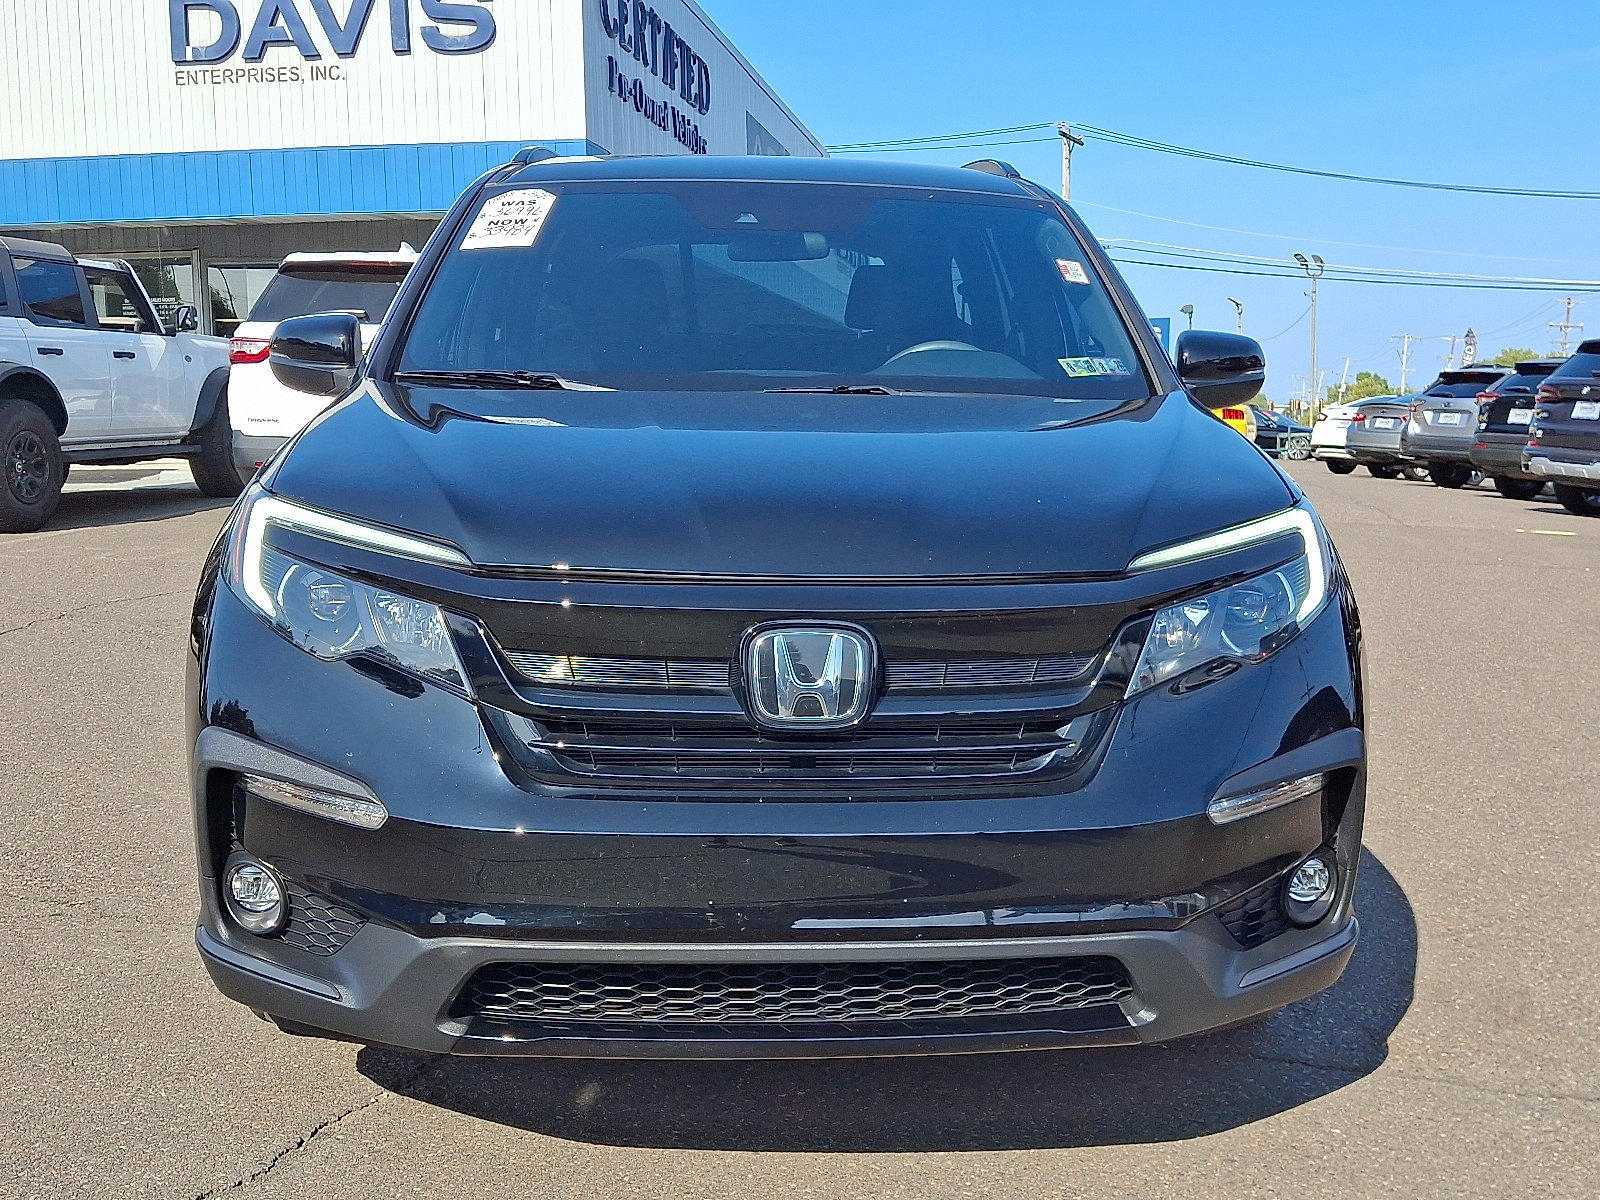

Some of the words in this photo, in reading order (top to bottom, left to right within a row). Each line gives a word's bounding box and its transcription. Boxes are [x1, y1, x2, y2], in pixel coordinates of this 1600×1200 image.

[169, 0, 497, 66] DAVIS
[600, 0, 711, 115] CERTIFIED
[174, 67, 306, 86] ENTERPRISES,
[310, 65, 346, 82] INC.
